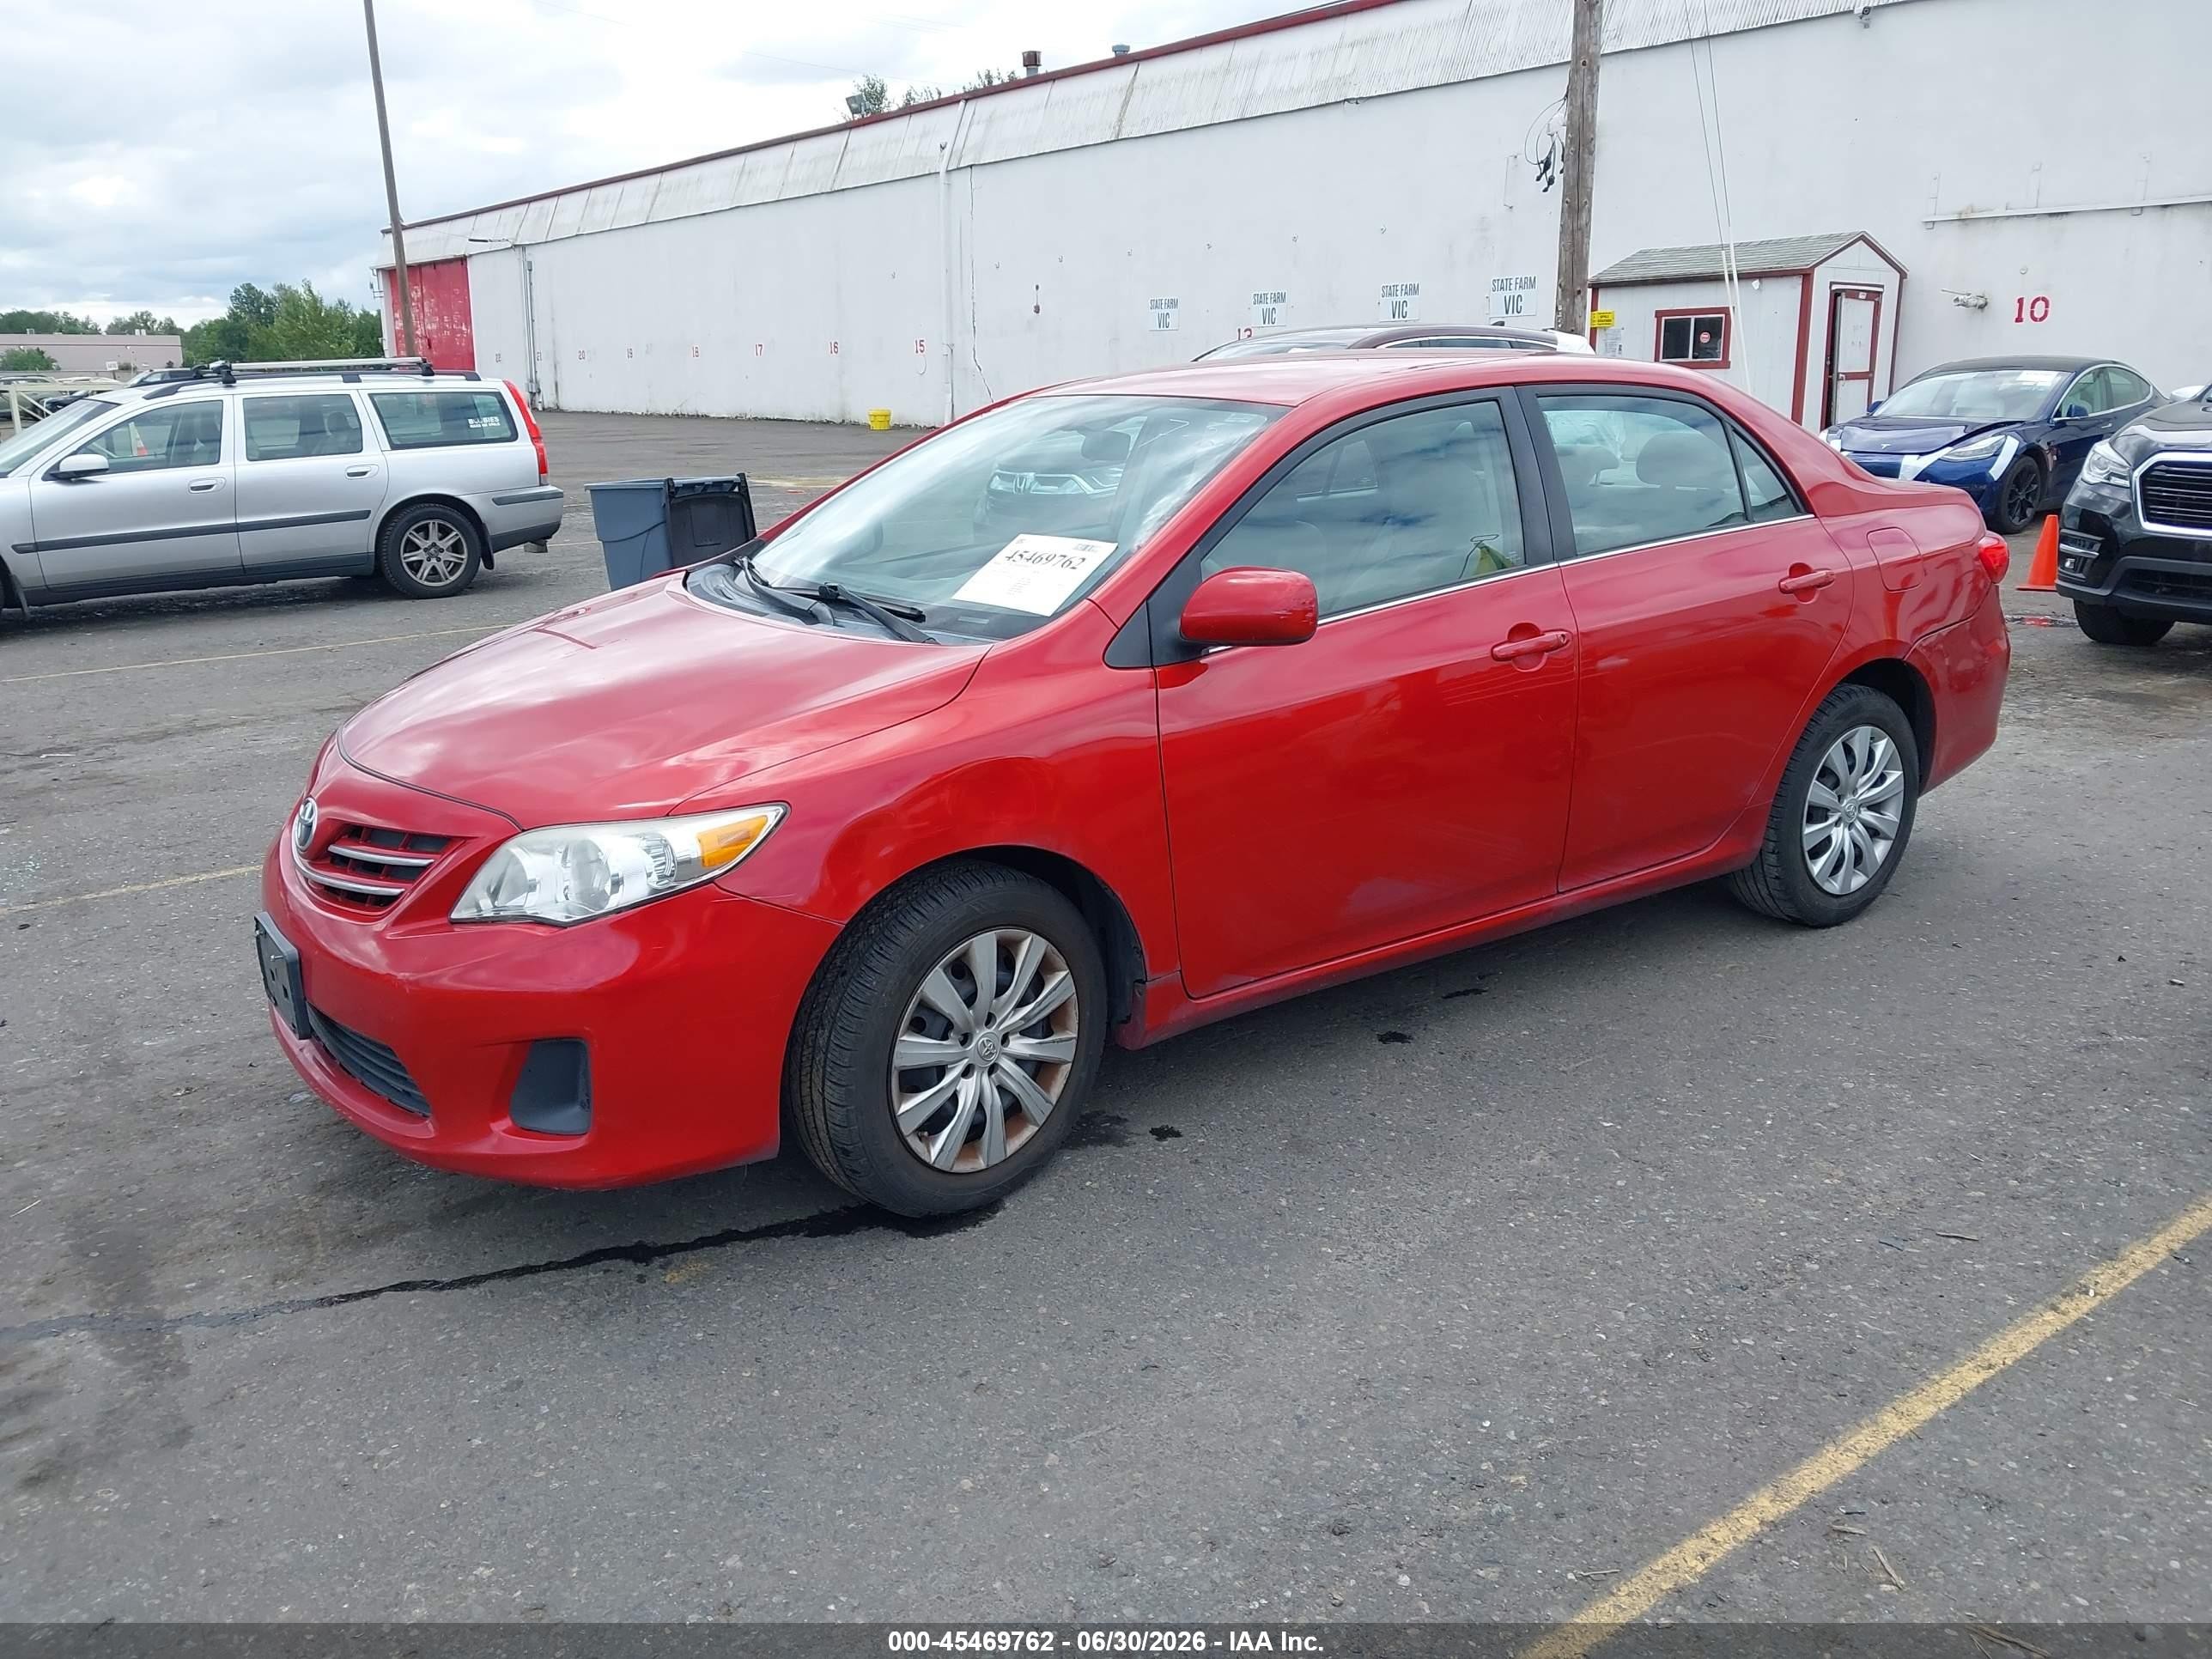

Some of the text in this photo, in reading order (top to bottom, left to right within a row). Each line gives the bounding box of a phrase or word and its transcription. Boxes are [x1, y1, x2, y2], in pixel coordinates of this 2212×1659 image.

[1381, 283, 1419, 298] STATE FARM
[1492, 276, 1537, 292] STATE FARM
[1150, 298, 1179, 310] STATE FARM
[1253, 291, 1286, 305] STATE FARM
[1504, 295, 1522, 315] VIC
[1261, 307, 1276, 325] VIC
[1391, 301, 1408, 319] VIC
[2014, 295, 2050, 323] 10
[1158, 313, 1170, 329] VIC
[755, 343, 763, 356] 17
[829, 341, 839, 355] 16
[915, 339, 926, 354] 15
[1005, 550, 1086, 570] 45469762
